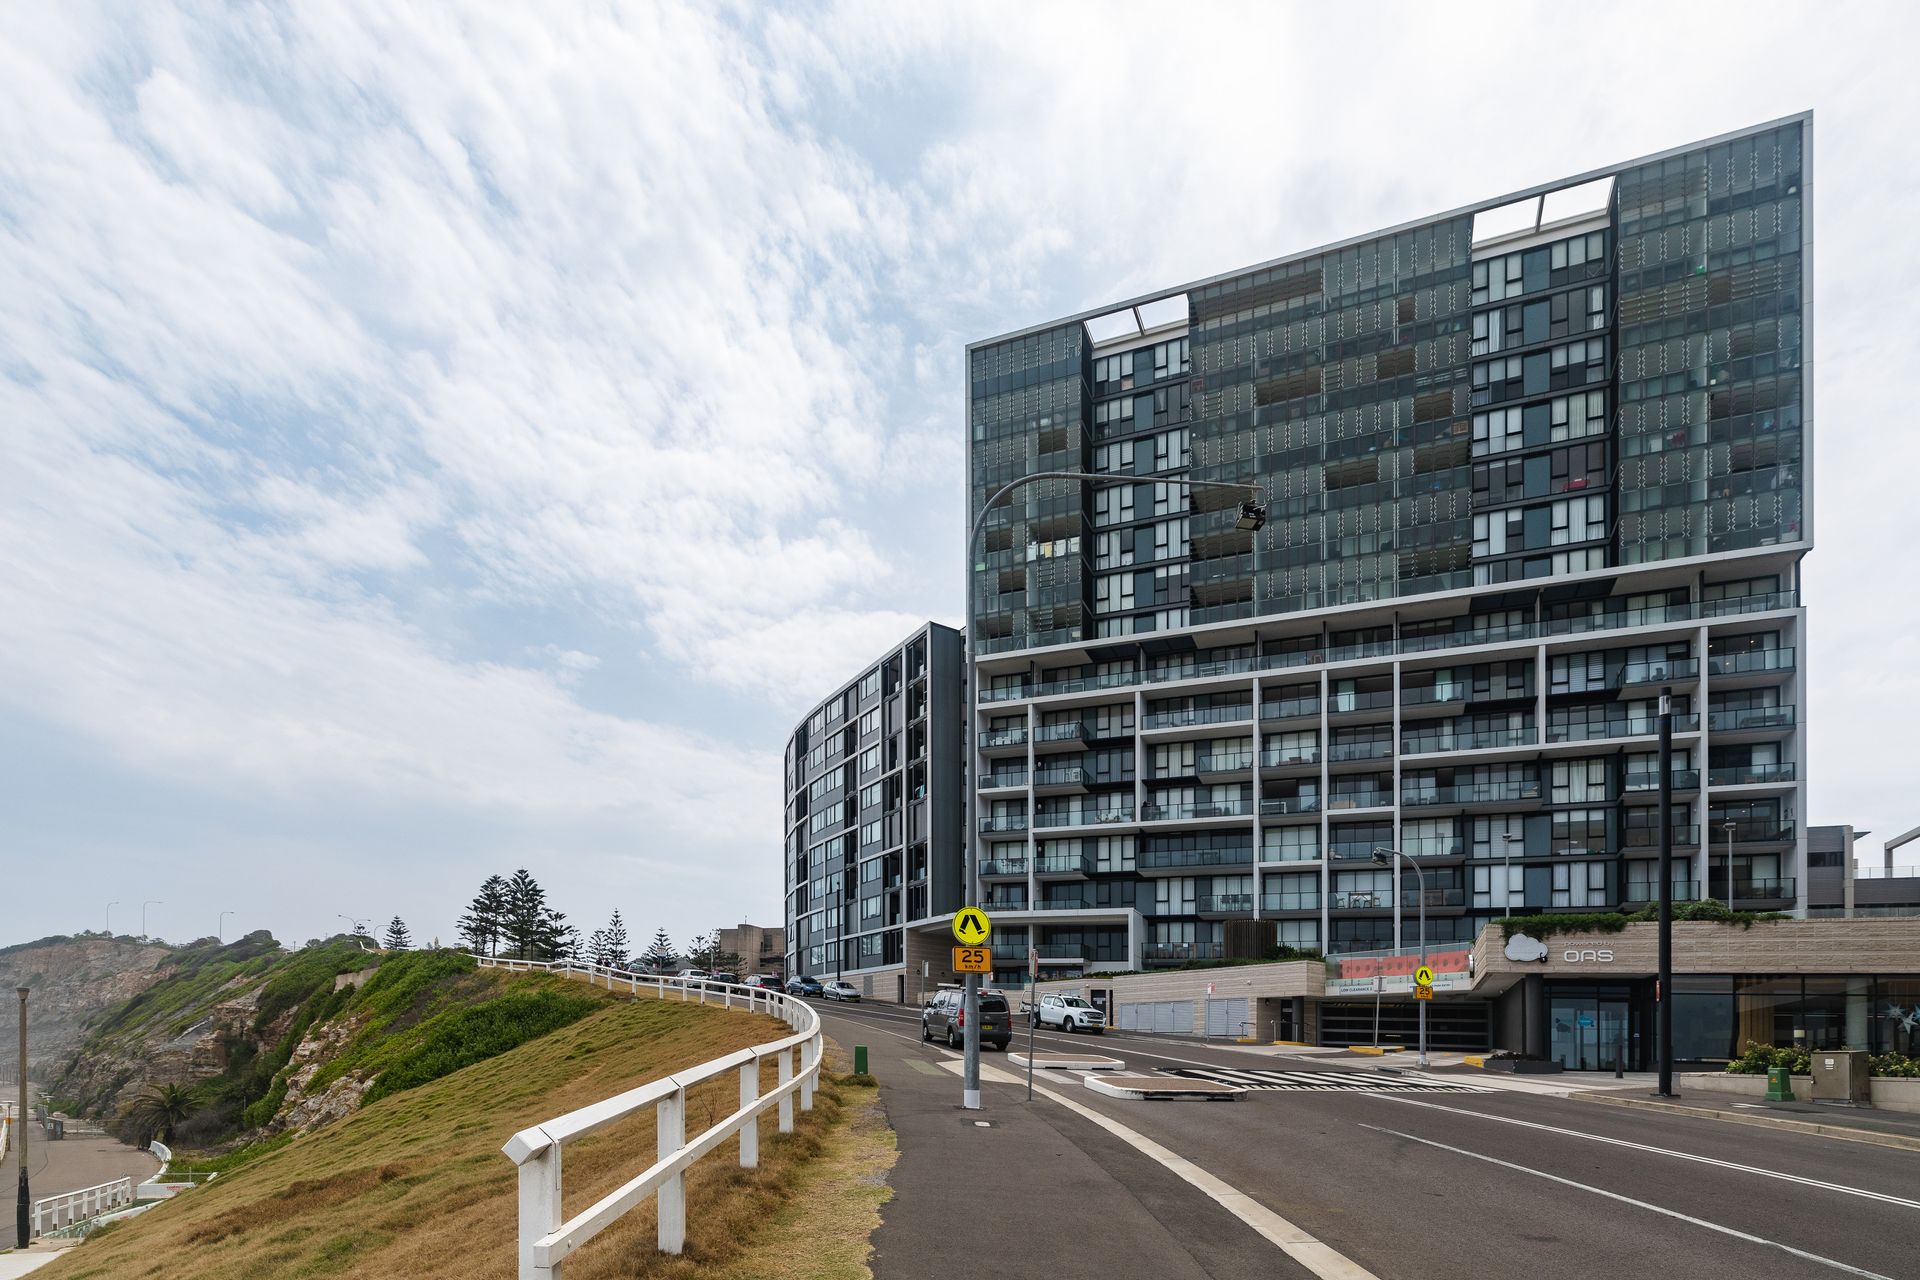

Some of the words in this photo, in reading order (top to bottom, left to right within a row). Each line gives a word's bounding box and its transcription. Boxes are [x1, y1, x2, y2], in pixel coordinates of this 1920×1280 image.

[961, 949, 984, 963] 25
[1564, 950, 1614, 962] OAS
[1419, 987, 1430, 995] 25
